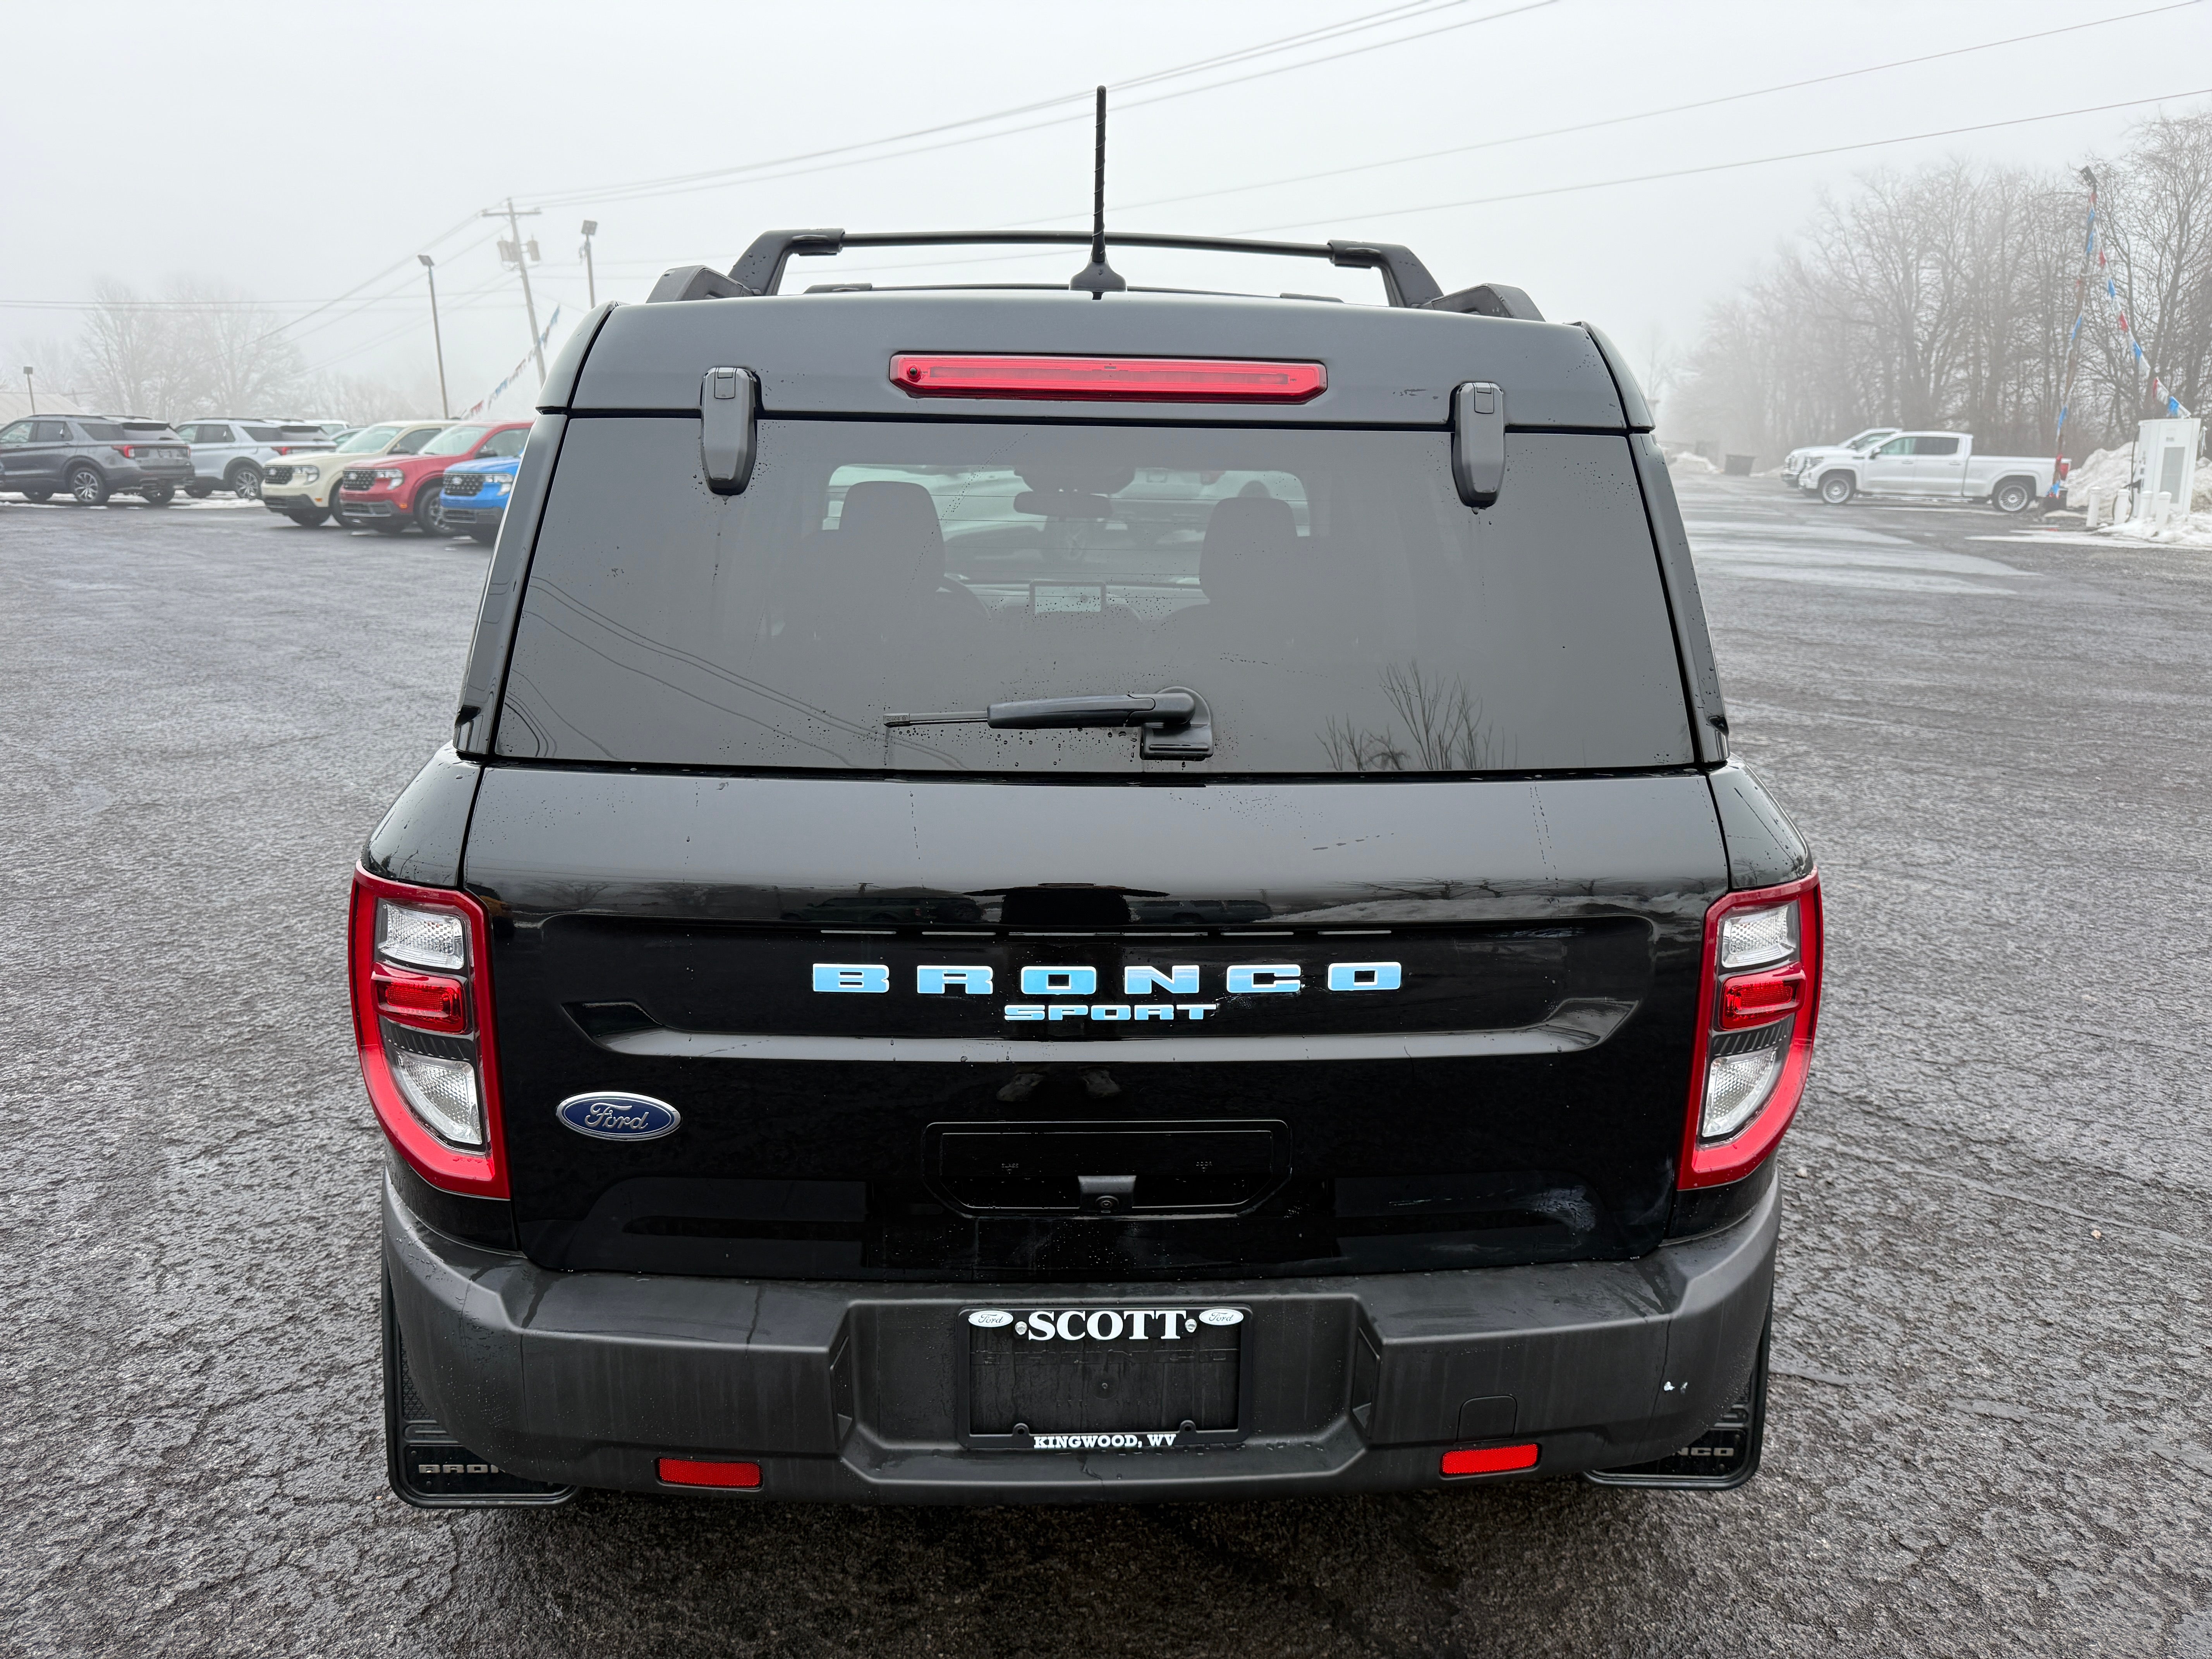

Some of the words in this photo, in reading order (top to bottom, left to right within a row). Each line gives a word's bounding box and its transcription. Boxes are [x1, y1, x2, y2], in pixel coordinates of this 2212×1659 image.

[812, 962, 1402, 995] BRONCO
[1005, 1004, 1216, 1020] SPORT
[584, 1102, 649, 1130] Ford
[978, 1314, 1003, 1323] Ford
[1209, 1312, 1234, 1321] Ford
[1028, 1310, 1187, 1341] SCOTT
[1034, 1434, 1142, 1449] KINGWOOD,
[1147, 1434, 1176, 1446] WV
